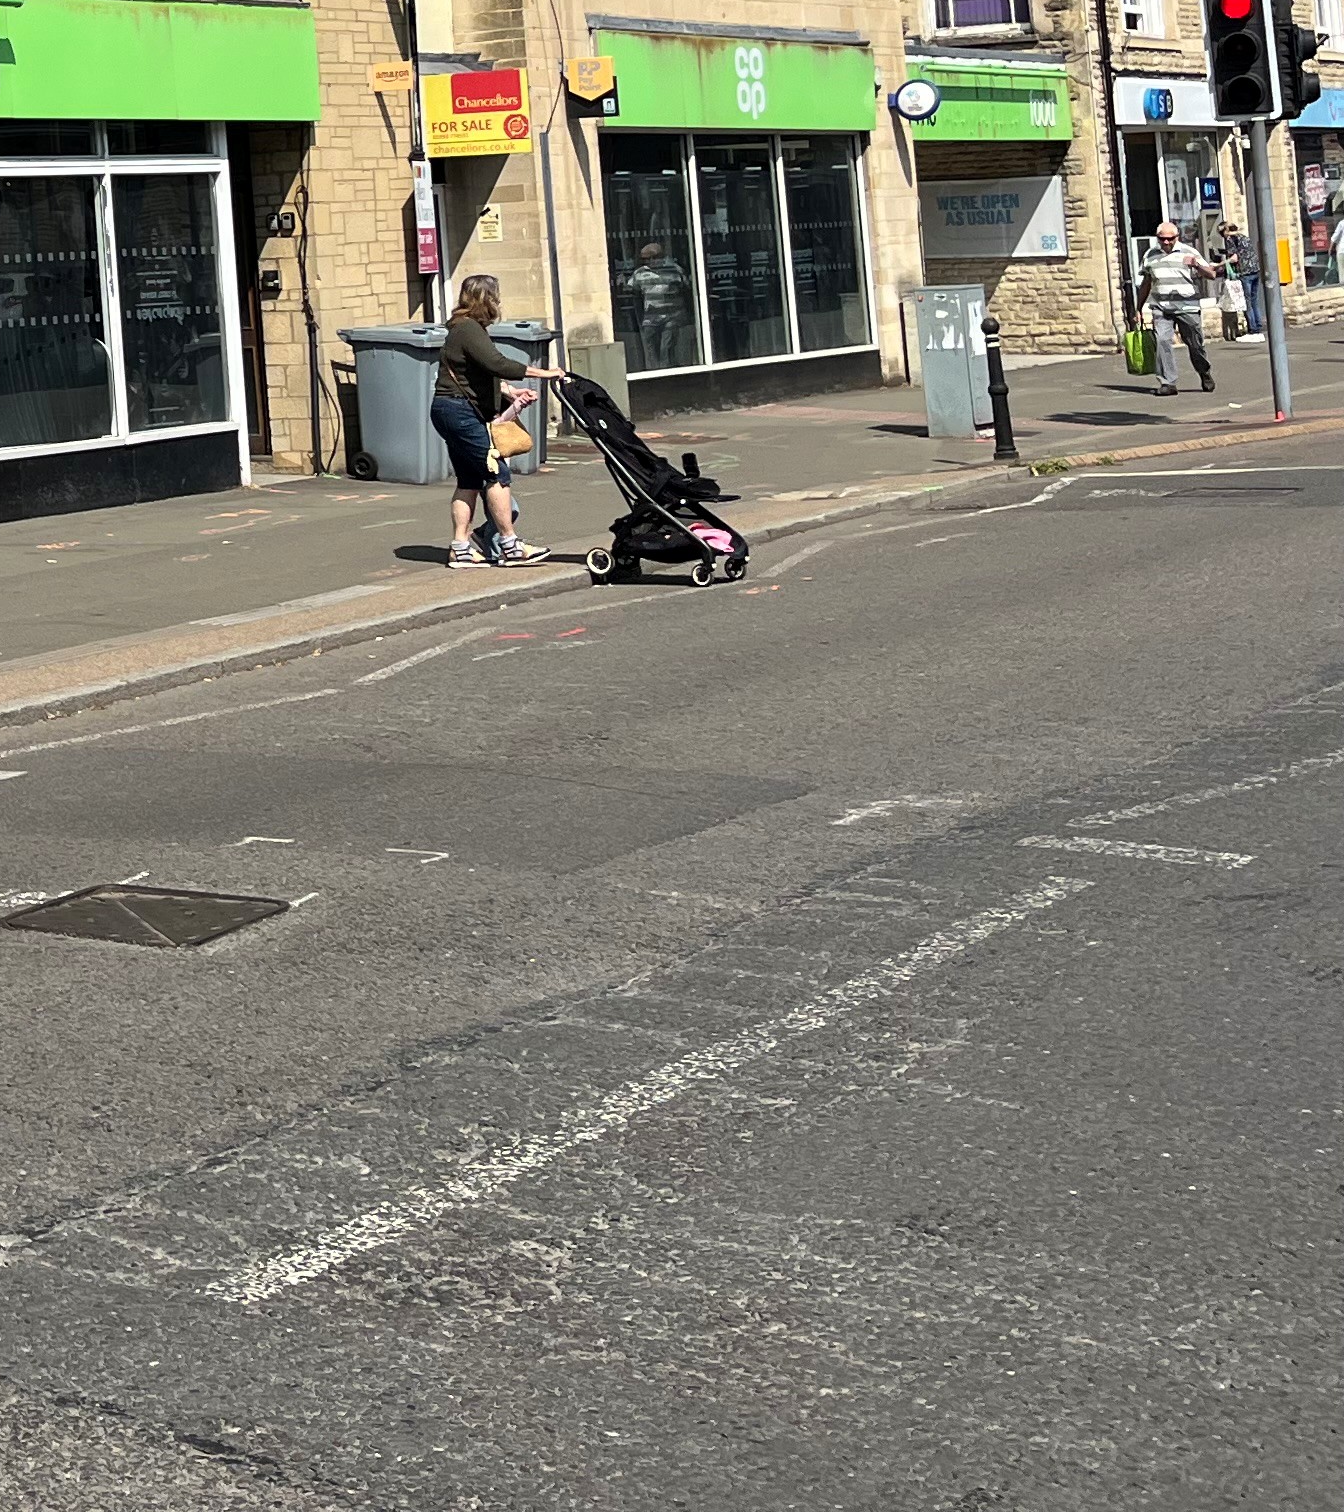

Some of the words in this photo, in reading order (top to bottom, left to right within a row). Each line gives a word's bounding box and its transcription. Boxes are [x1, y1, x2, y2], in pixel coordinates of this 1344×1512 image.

[376, 70, 409, 79] amazon
[455, 93, 519, 109] Chancellors
[431, 122, 458, 134] FOR
[462, 119, 493, 132] SALE
[936, 195, 978, 210] WE'RE
[981, 193, 1020, 209] OPEN
[945, 211, 965, 226] AS
[967, 210, 1014, 226] USUAL
